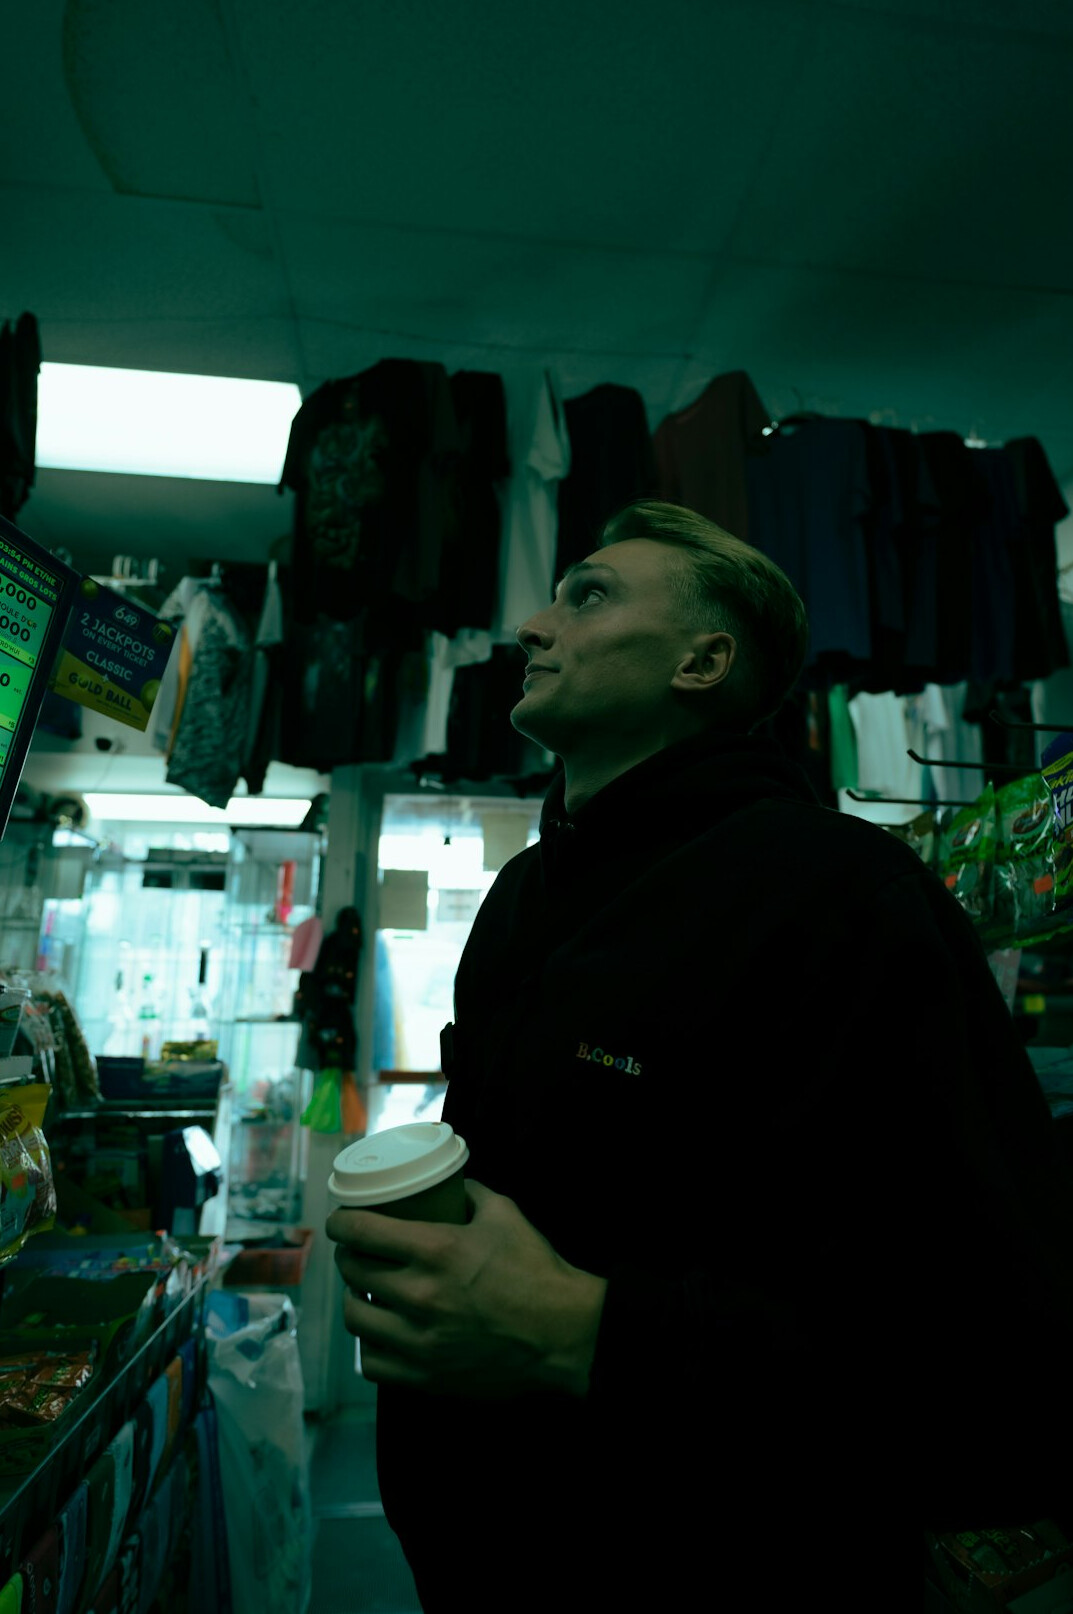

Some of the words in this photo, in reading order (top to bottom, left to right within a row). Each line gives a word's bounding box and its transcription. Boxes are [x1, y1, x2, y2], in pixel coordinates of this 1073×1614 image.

[81, 612, 91, 626] 2
[91, 618, 156, 661] JACKPOTS
[82, 627, 97, 641] ON
[97, 635, 122, 654] EVERY
[123, 648, 148, 668] TICKET
[86, 650, 133, 681] CLASSIC
[68, 672, 103, 695] GOLD
[106, 689, 132, 711] BALL
[575, 1041, 643, 1076] B.Cools
